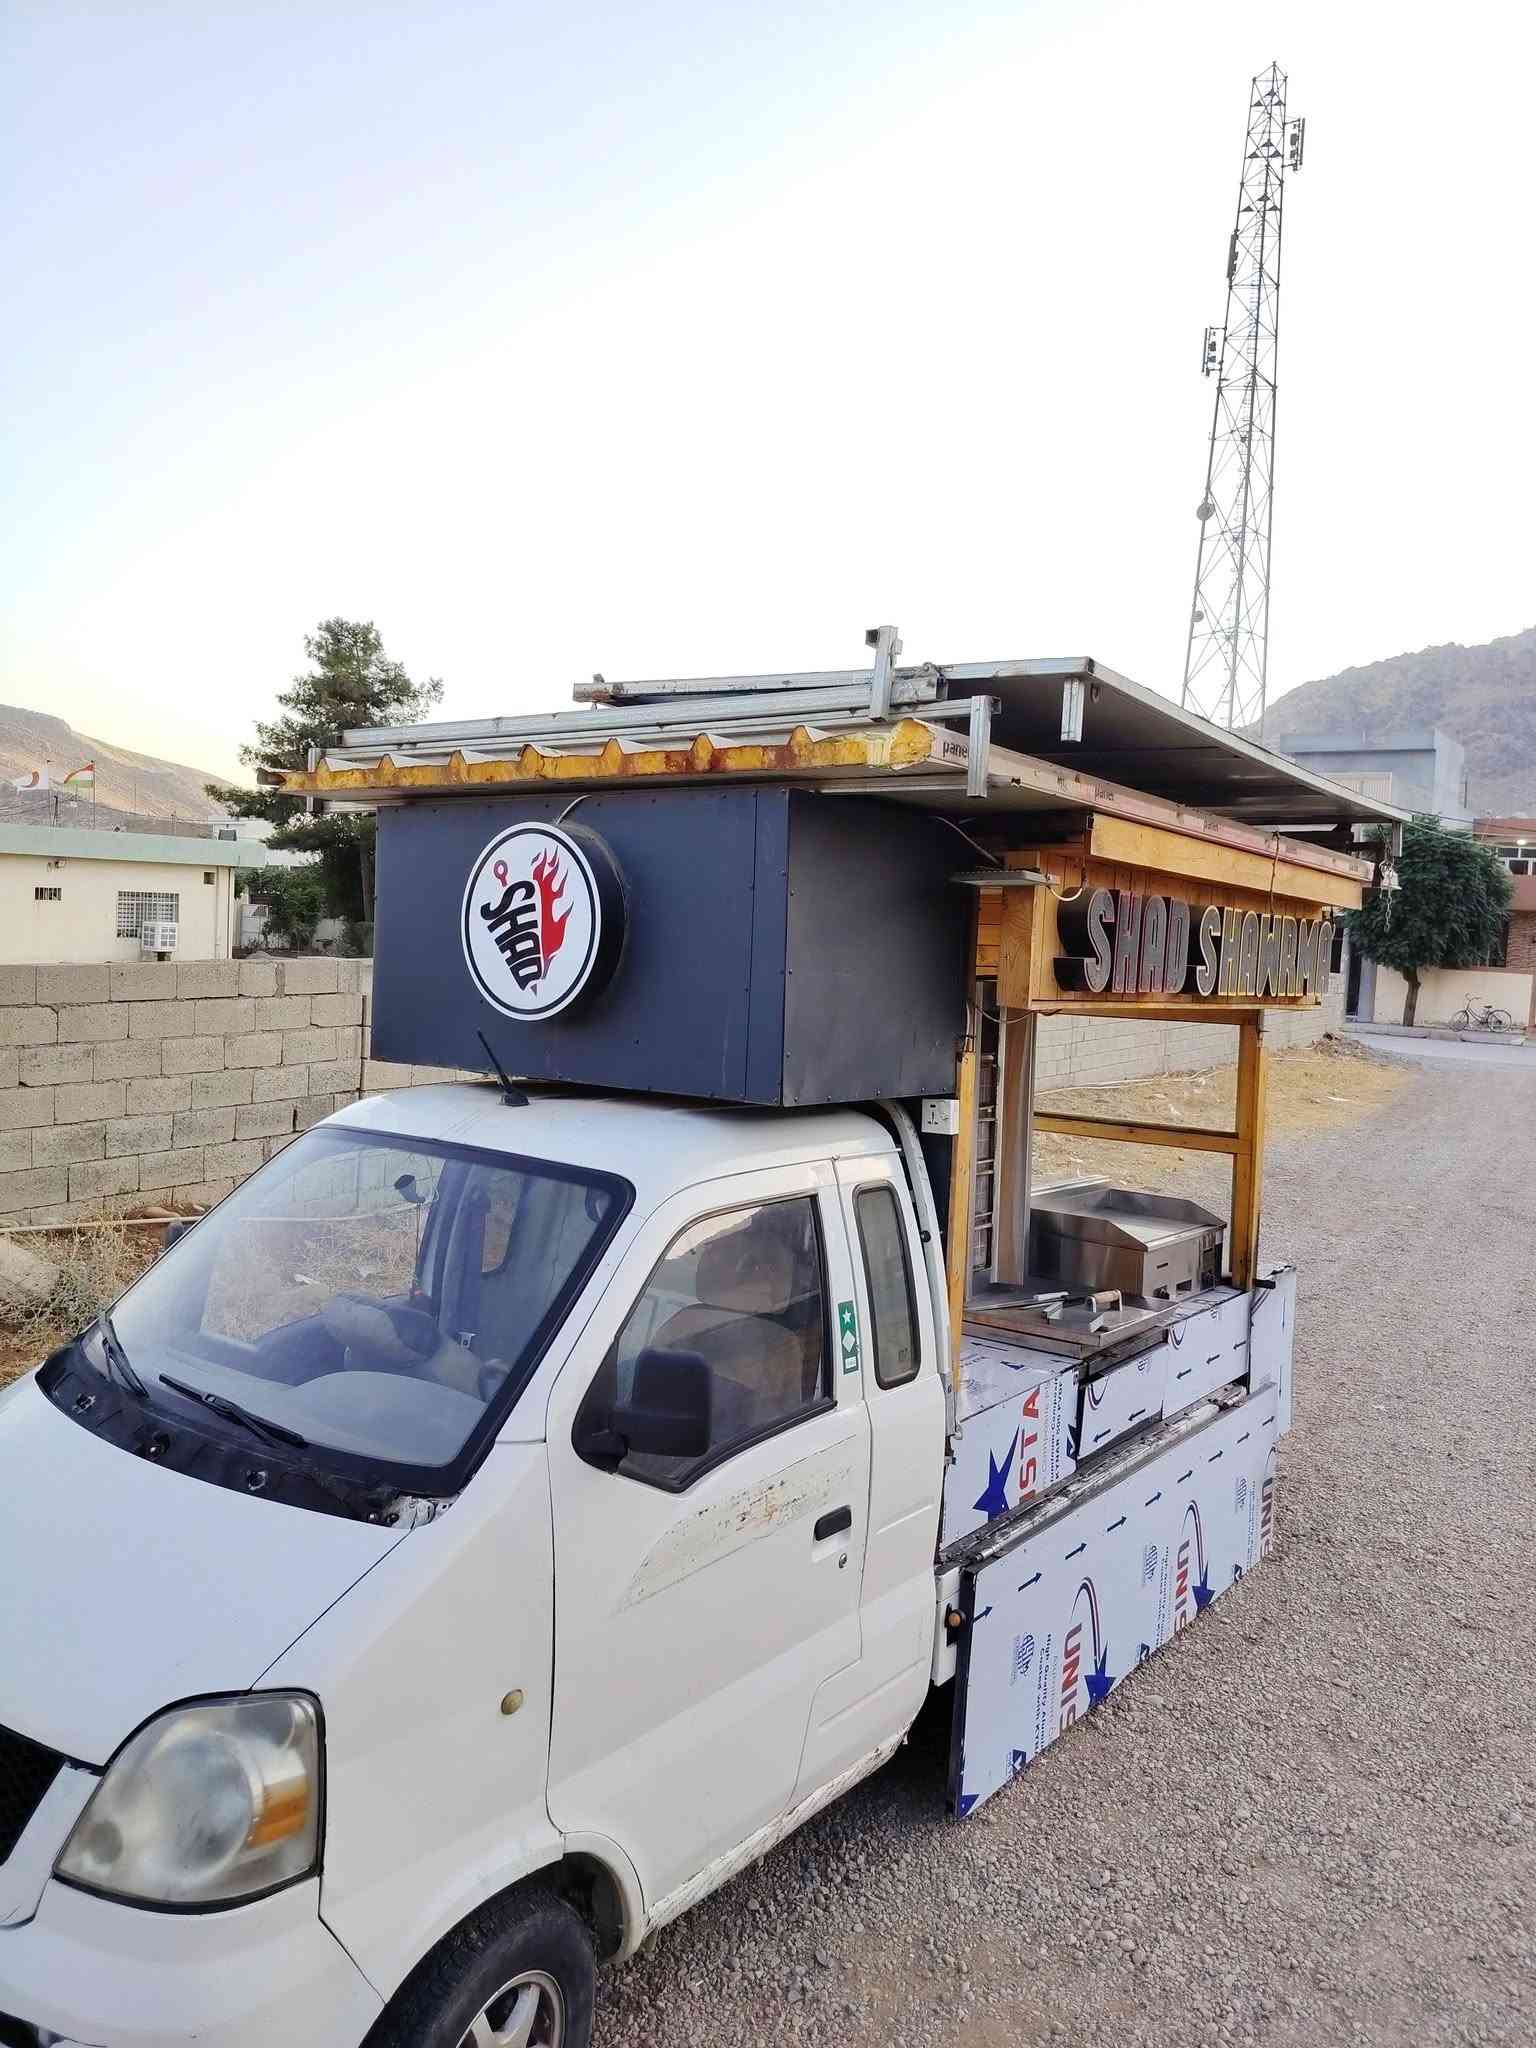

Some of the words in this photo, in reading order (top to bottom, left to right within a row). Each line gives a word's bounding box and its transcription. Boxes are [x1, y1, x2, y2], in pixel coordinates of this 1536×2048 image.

[480, 880, 543, 991] SHAD
[1084, 887, 1191, 993] SHAD
[1196, 904, 1335, 997] SHAWRMA
